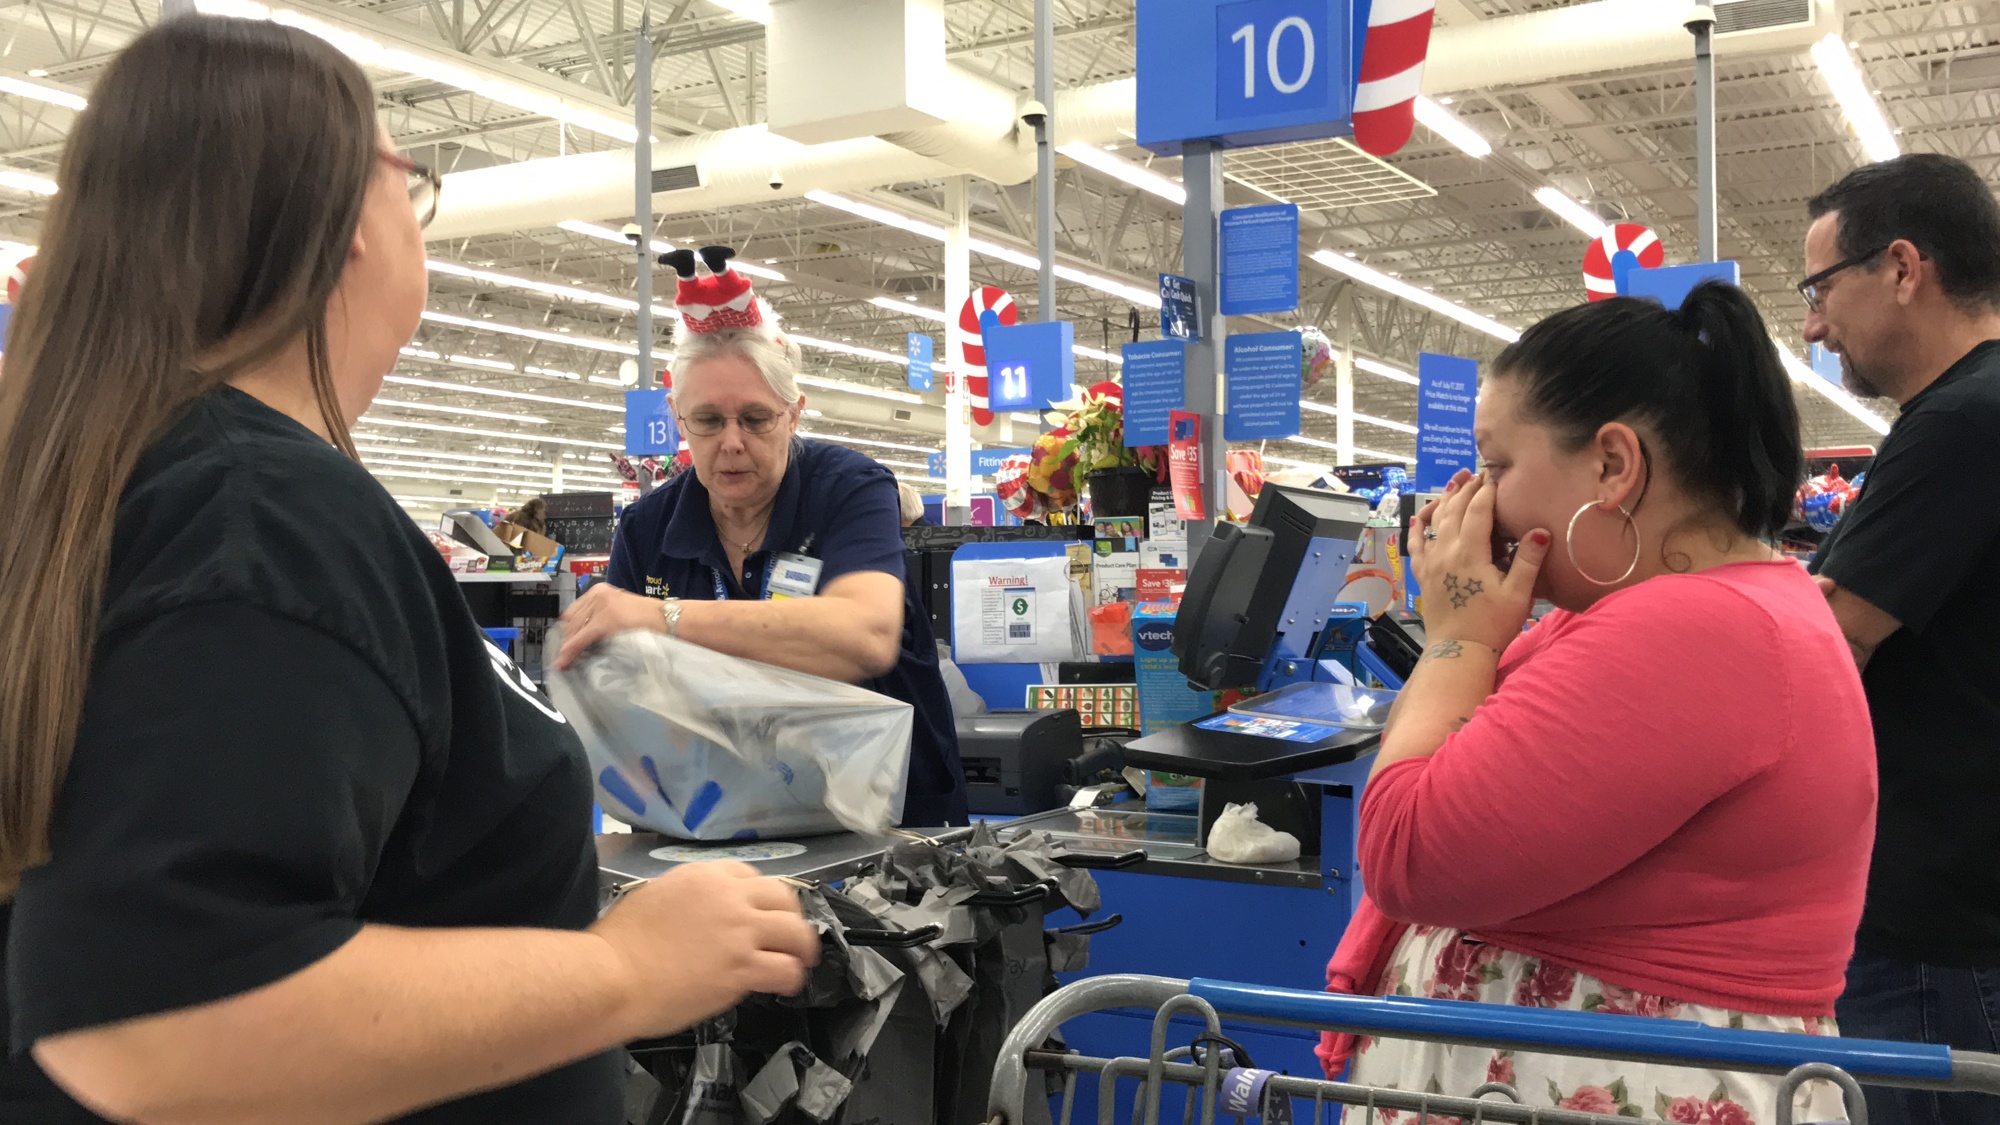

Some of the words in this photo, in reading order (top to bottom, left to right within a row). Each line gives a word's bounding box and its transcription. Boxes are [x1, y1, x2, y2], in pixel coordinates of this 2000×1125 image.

[1232, 16, 1315, 98] 10
[1259, 344, 1294, 352] Consumer:
[1000, 366, 1027, 399] 11
[1458, 394, 1471, 404] longer
[648, 421, 667, 445] 13
[1171, 444, 1186, 461] Save
[1187, 446, 1198, 462] $35
[988, 575, 1029, 586] Warning!
[1142, 579, 1161, 587] Save
